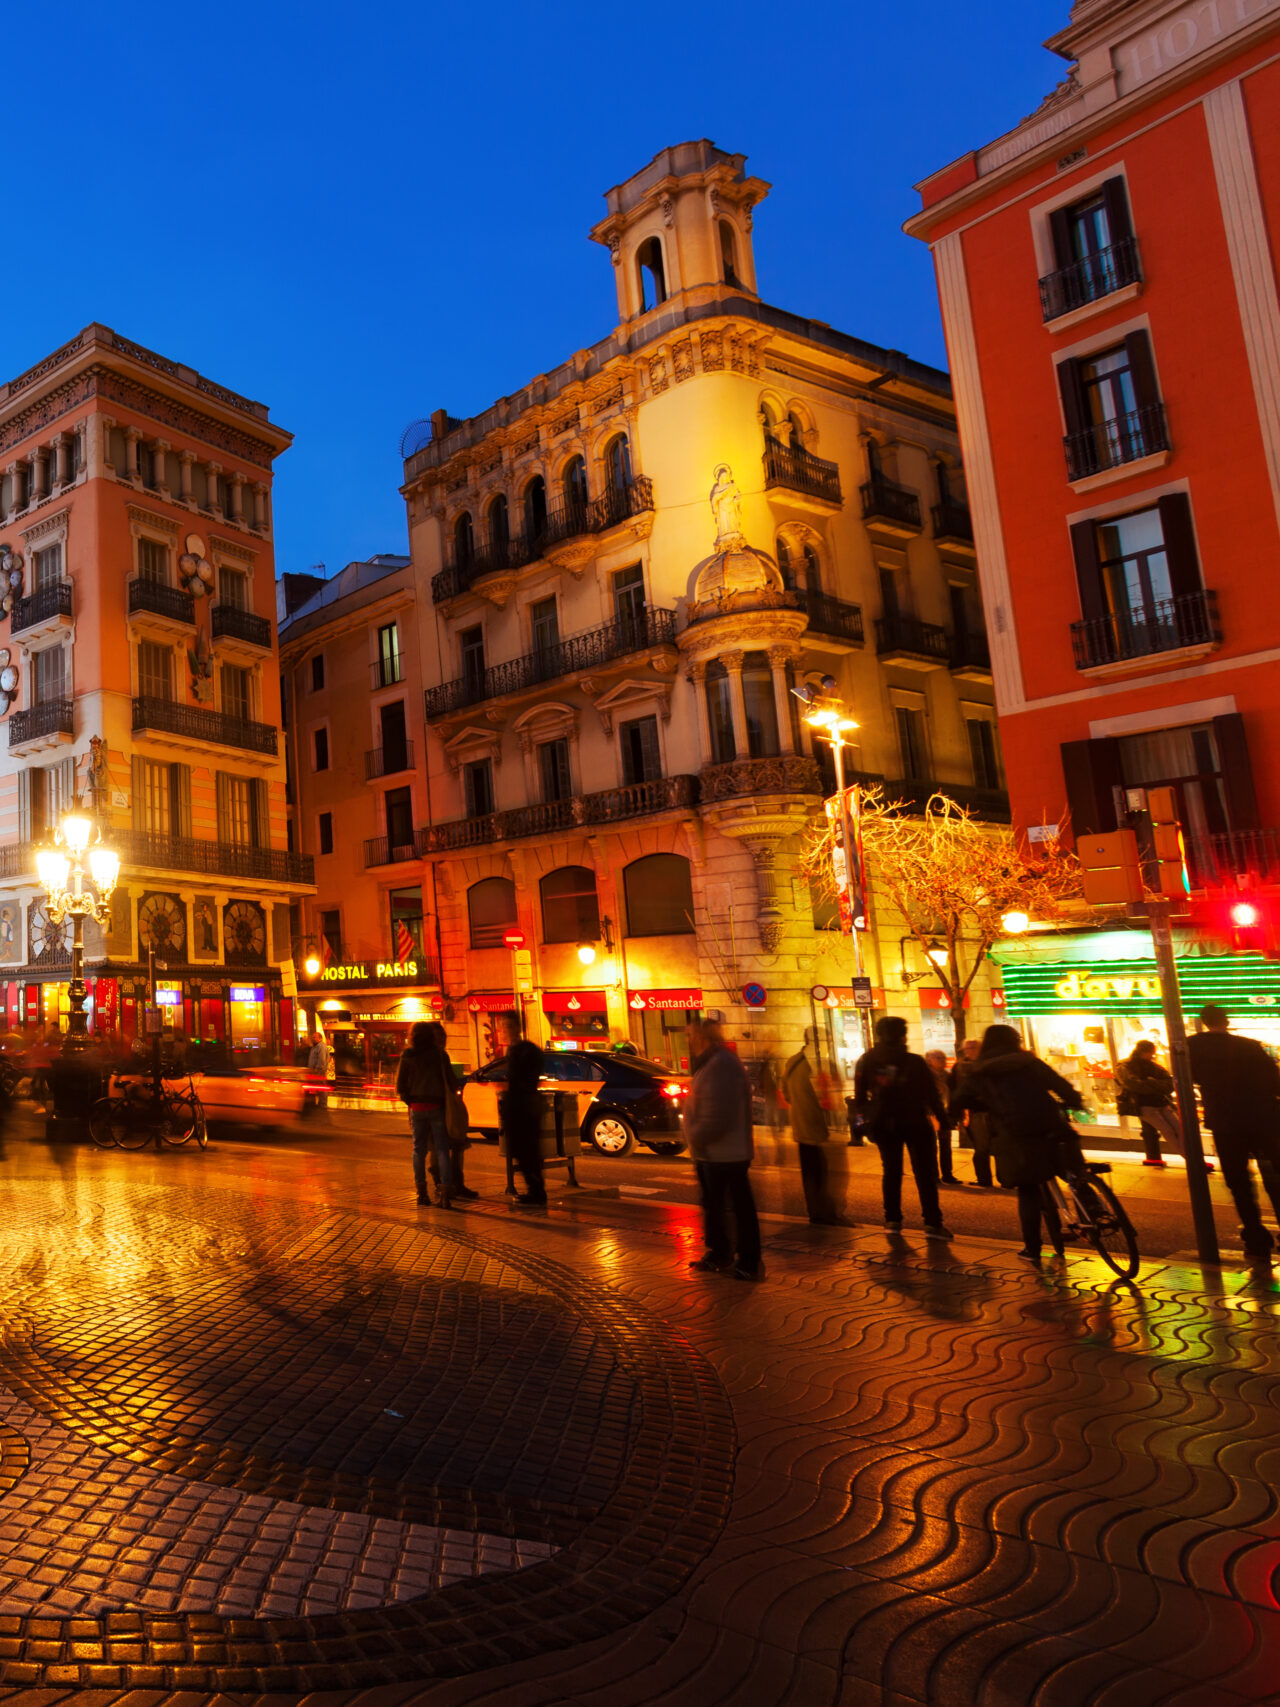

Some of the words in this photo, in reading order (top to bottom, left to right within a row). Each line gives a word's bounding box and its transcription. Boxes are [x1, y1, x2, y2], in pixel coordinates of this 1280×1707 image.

[321, 966, 368, 980] HOSTAL
[376, 961, 417, 978] PARIS
[648, 995, 703, 1009] Santander
